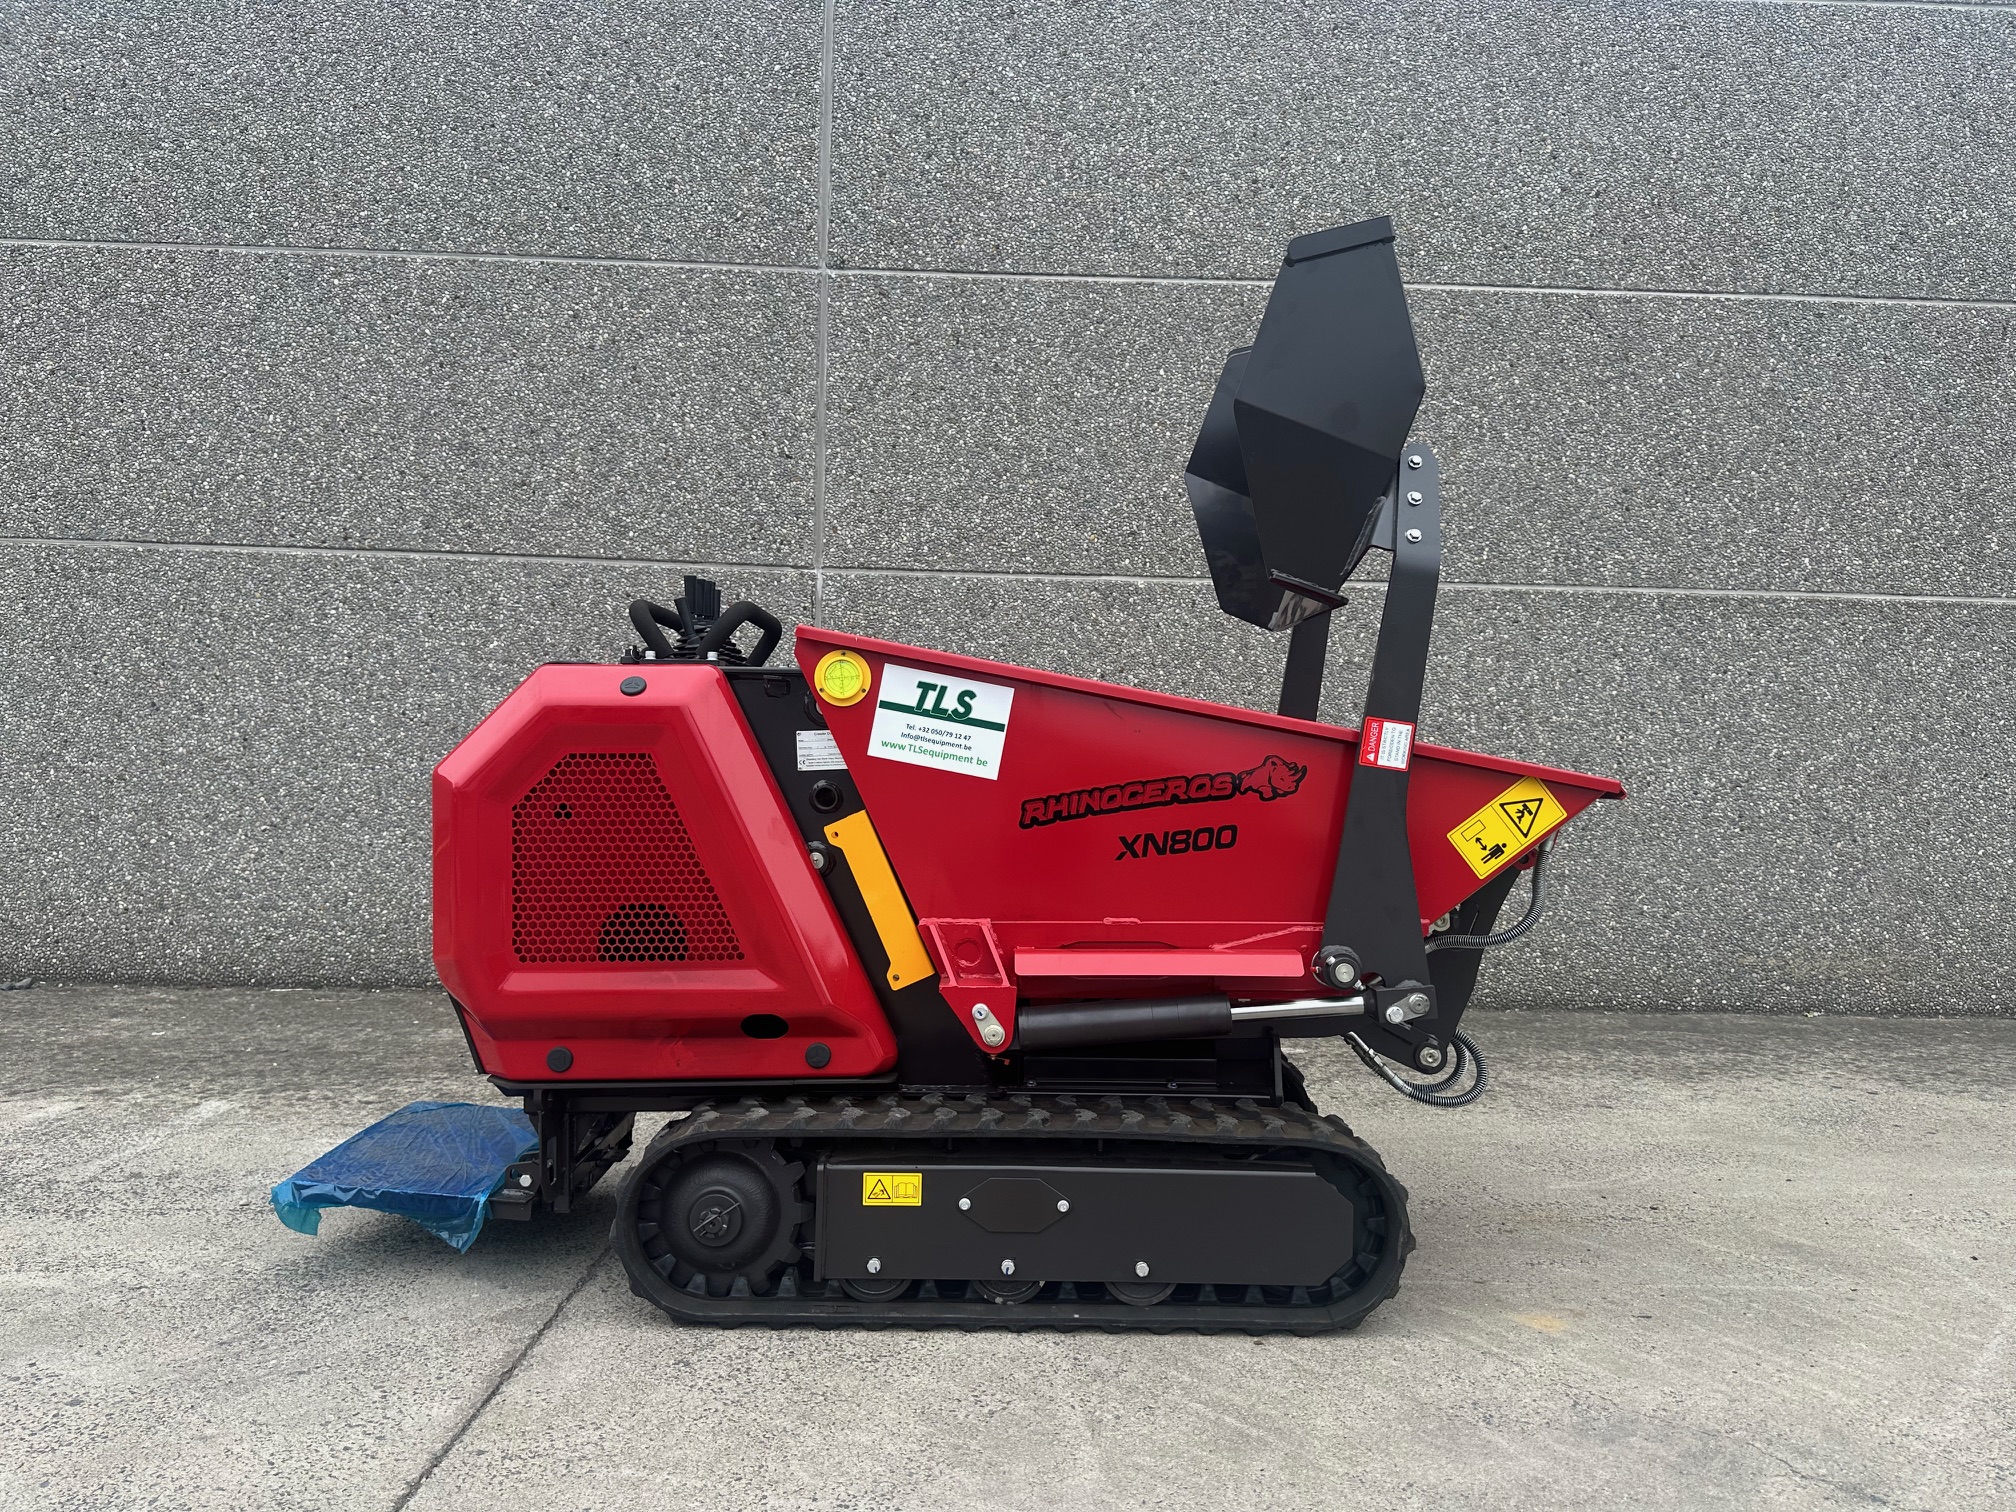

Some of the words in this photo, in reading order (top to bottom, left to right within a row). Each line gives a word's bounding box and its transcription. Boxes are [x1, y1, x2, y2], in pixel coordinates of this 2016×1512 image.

[914, 680, 977, 720] TLS
[900, 732, 972, 751] Info@tlsequipment.be
[906, 723, 916, 731] Tel.
[918, 726, 930, 734] +32
[931, 728, 953, 737] 050/79
[963, 734, 972, 742] 47
[1368, 722, 1379, 752] DANGER
[1019, 772, 1238, 829] RHINOCEROS
[1114, 825, 1238, 861] XN800
